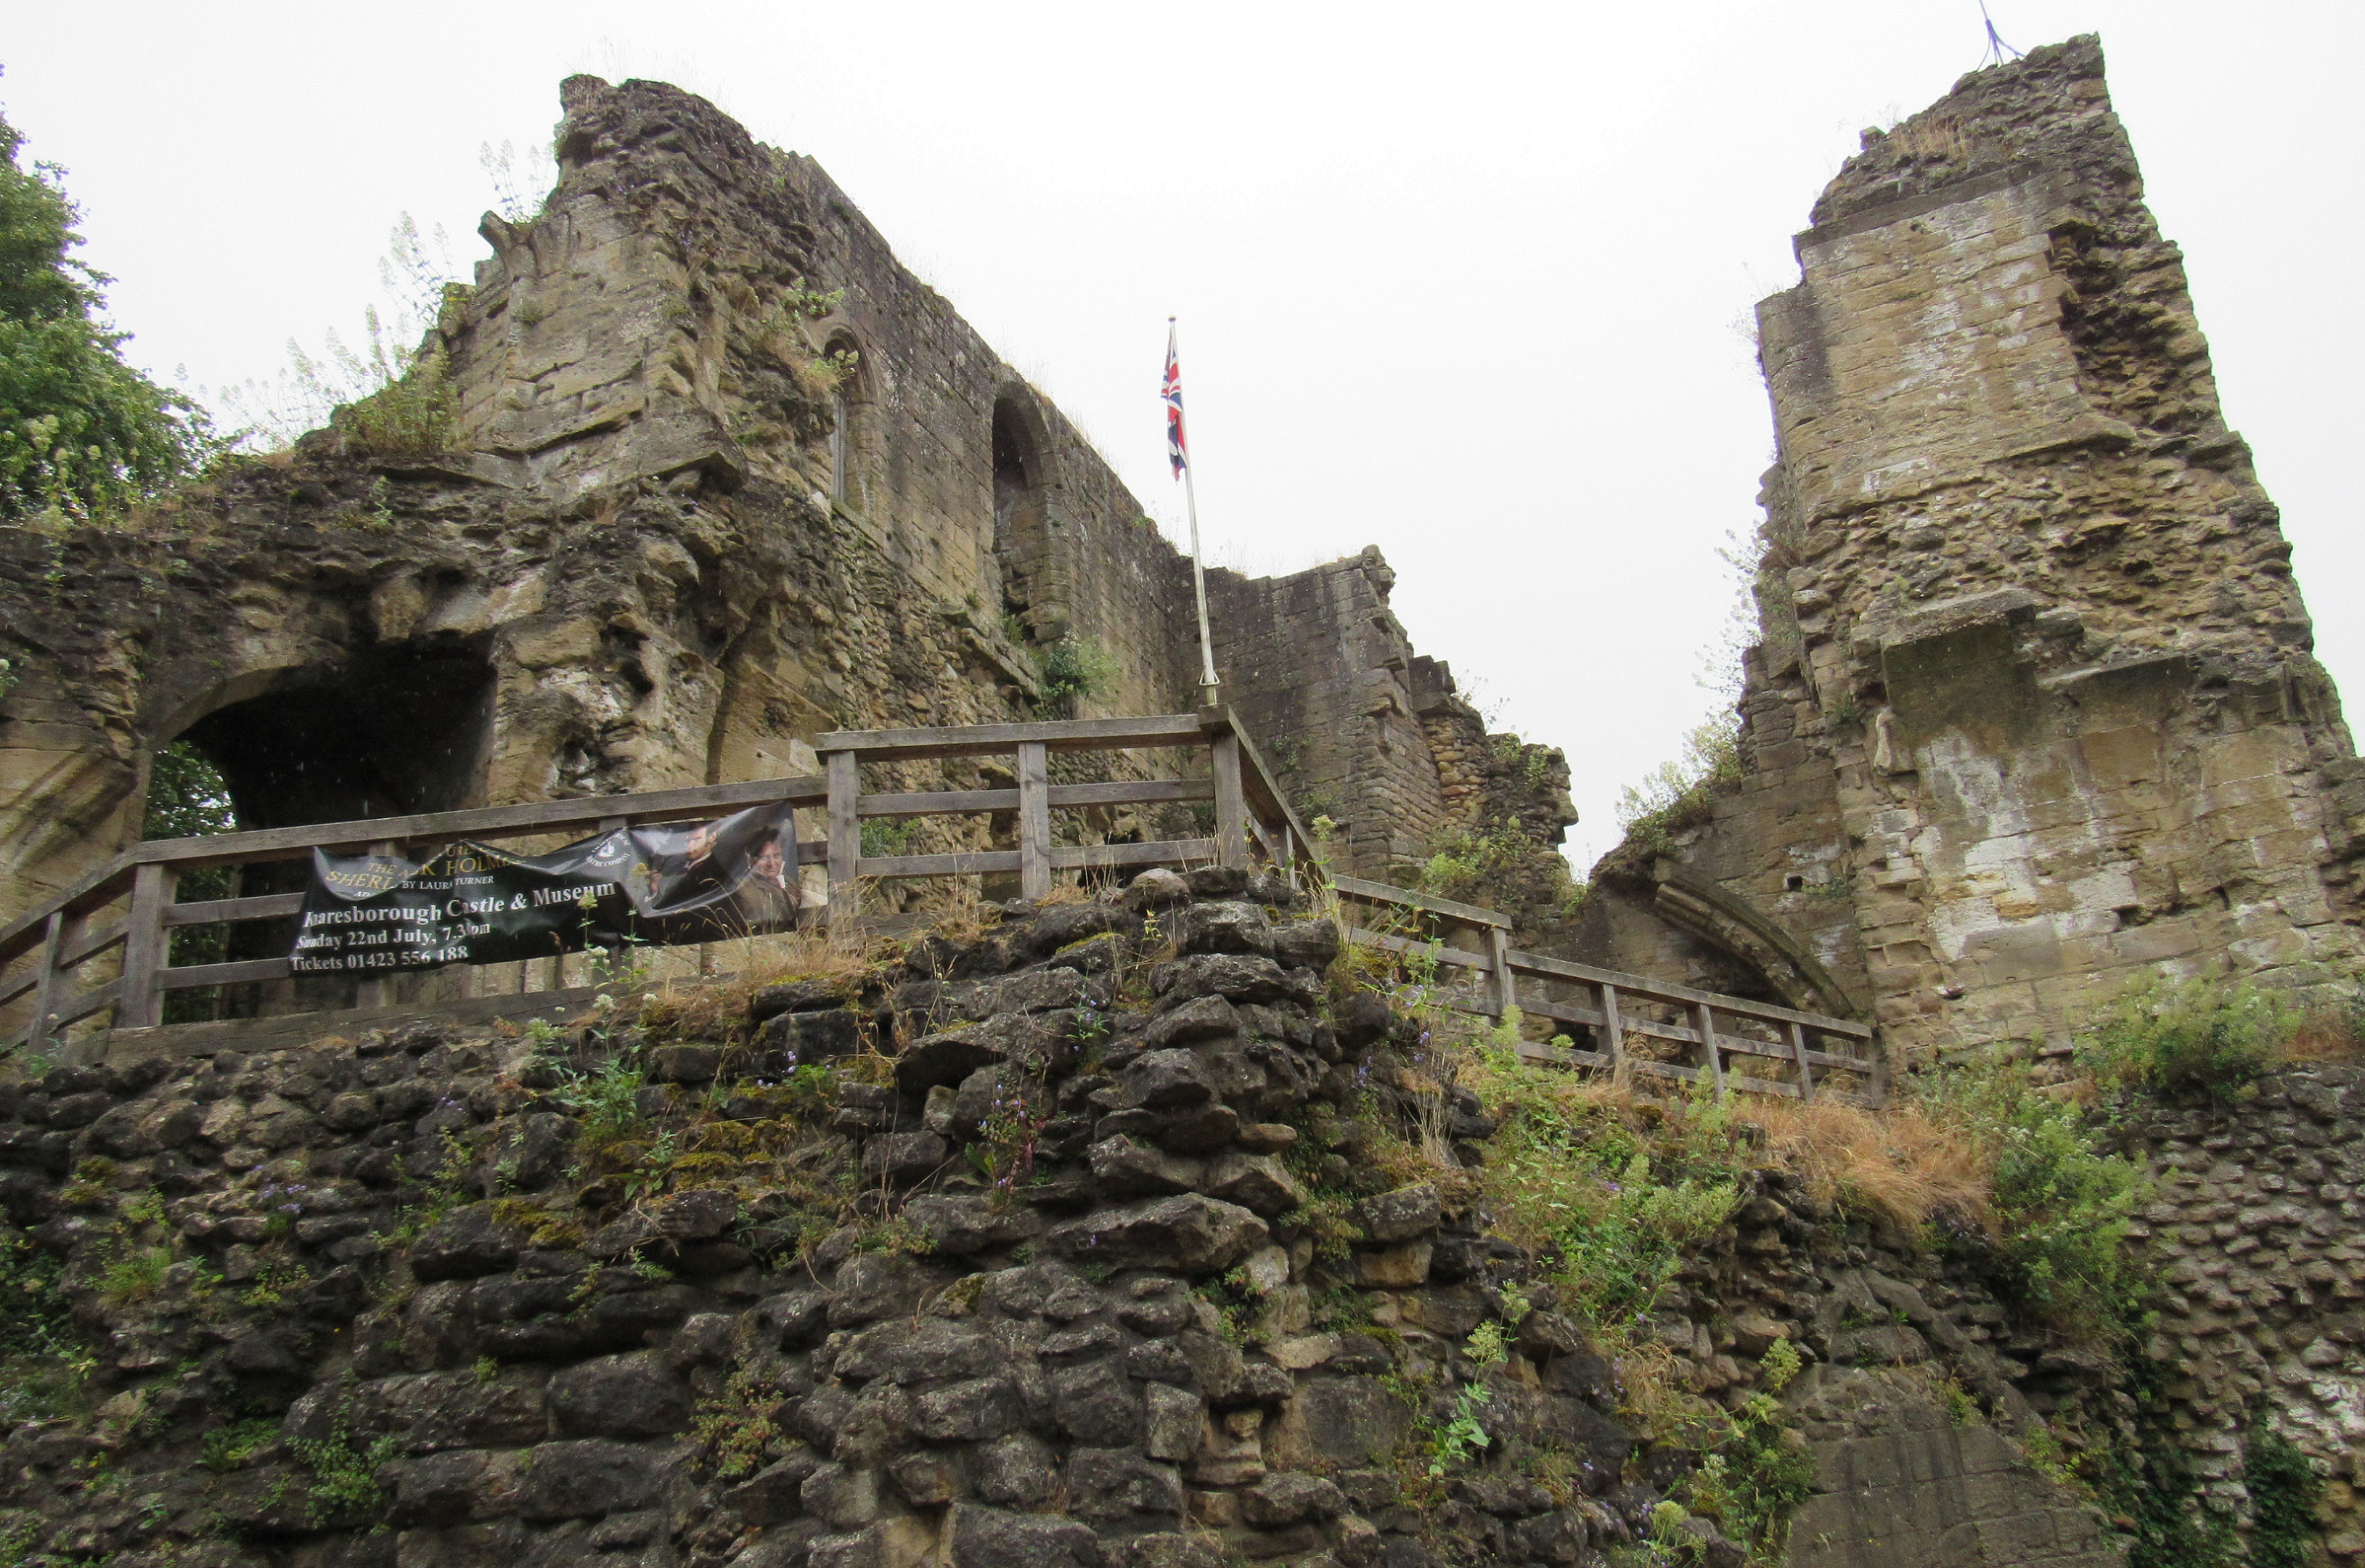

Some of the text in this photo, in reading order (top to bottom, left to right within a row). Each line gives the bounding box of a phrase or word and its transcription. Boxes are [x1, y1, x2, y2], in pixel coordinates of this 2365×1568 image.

[367, 862, 398, 874] THE
[402, 875, 494, 890] BY LAURA TURNER
[510, 893, 528, 910] &
[297, 934, 343, 950] Sunday
[348, 930, 388, 945] 22nd
[393, 928, 437, 946] July,
[292, 945, 468, 971] Tickets 01423 556 188
